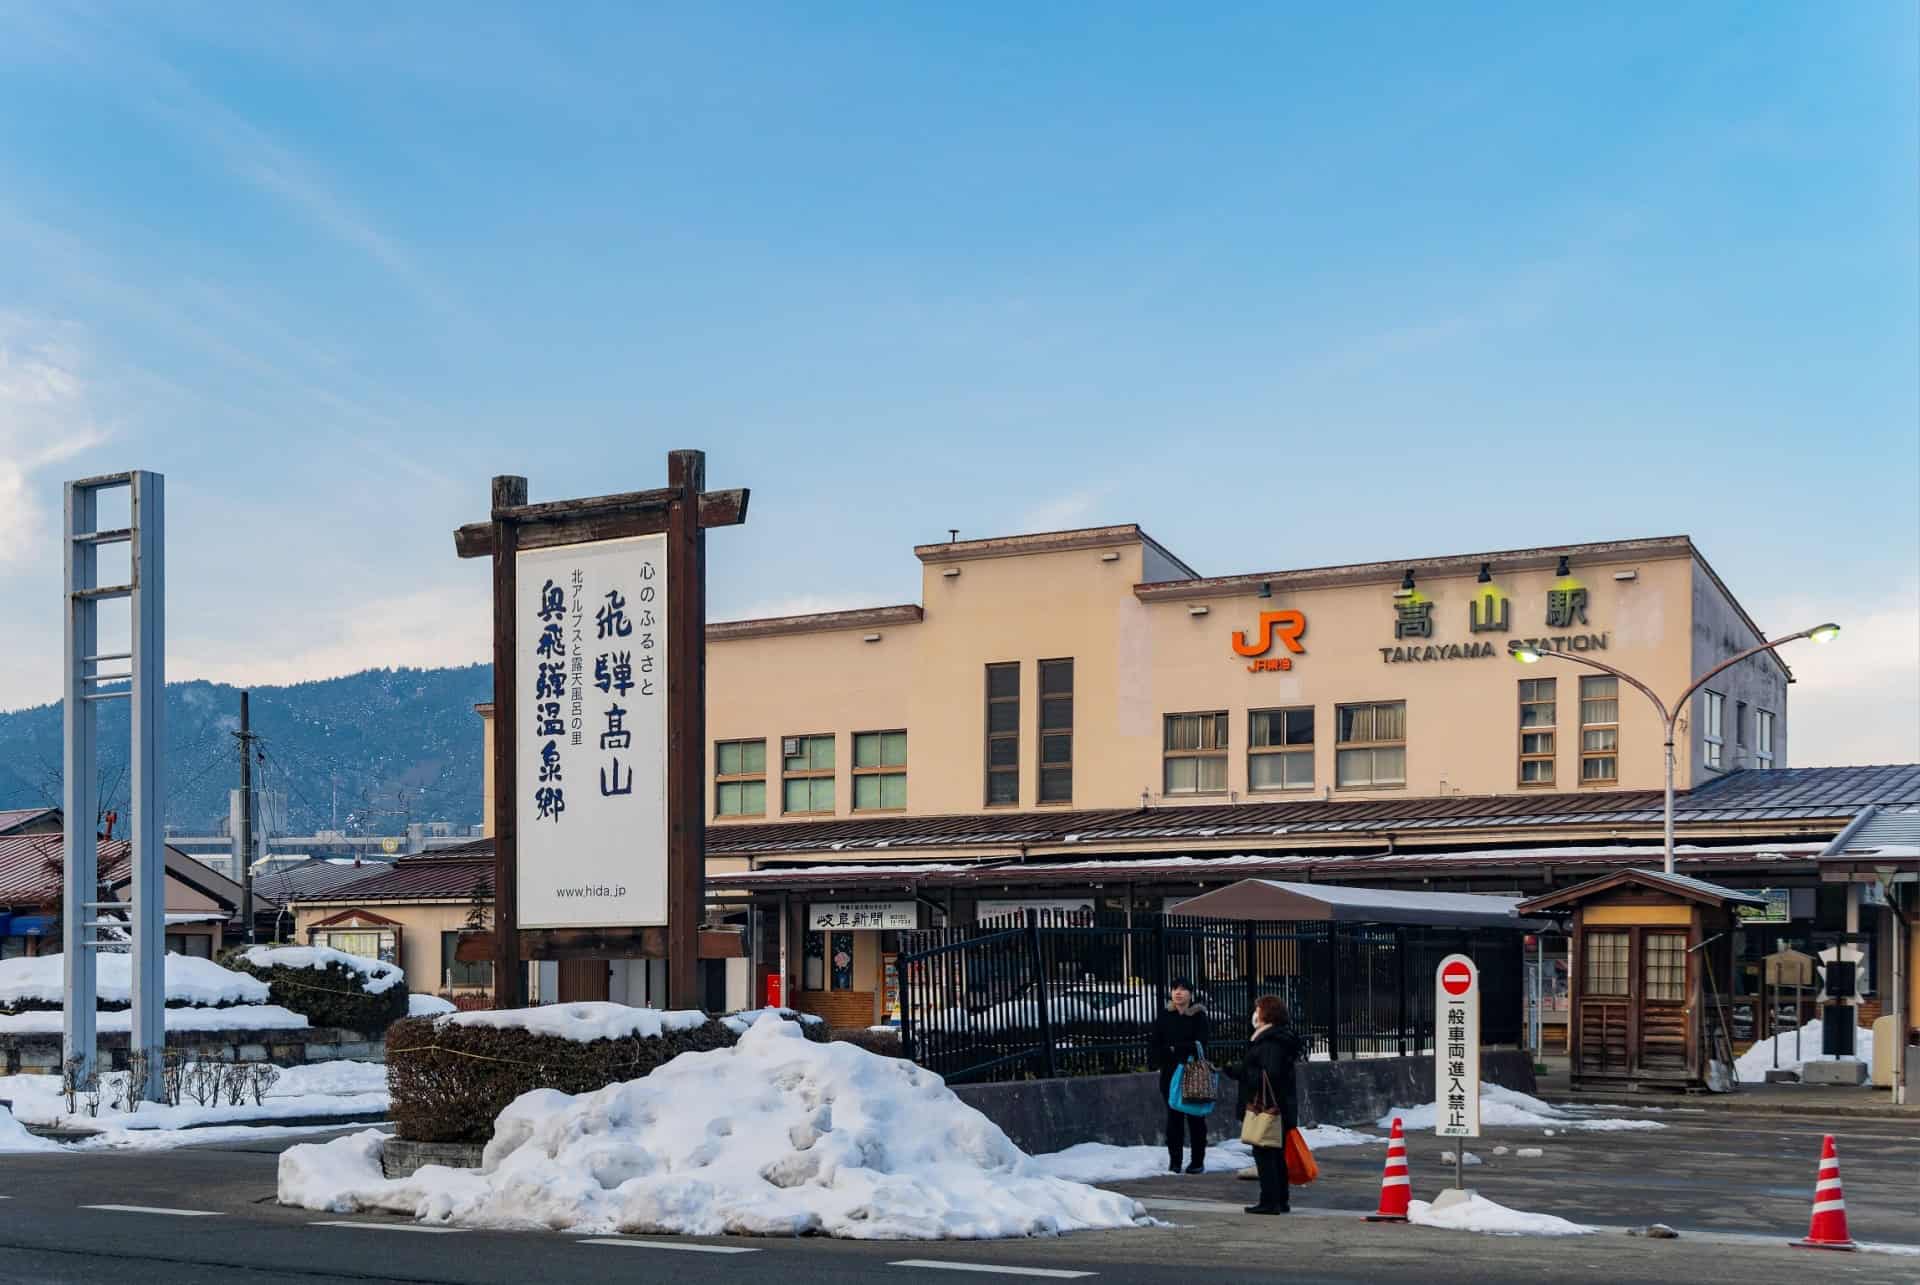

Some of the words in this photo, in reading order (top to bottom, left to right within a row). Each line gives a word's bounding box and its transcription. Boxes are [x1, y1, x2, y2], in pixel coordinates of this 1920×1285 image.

[639, 561, 656, 696] 心のふるさと
[1232, 610, 1306, 656] JR
[1379, 640, 1496, 664] TAKAYAMA
[1507, 635, 1608, 655] STATION
[571, 568, 584, 746] 北アルプスと露天風呂の里
[556, 884, 626, 898] www.hida.jp
[817, 912, 883, 928] 岐阜新聞
[1447, 1001, 1465, 1127] 一般車両進入禁止
